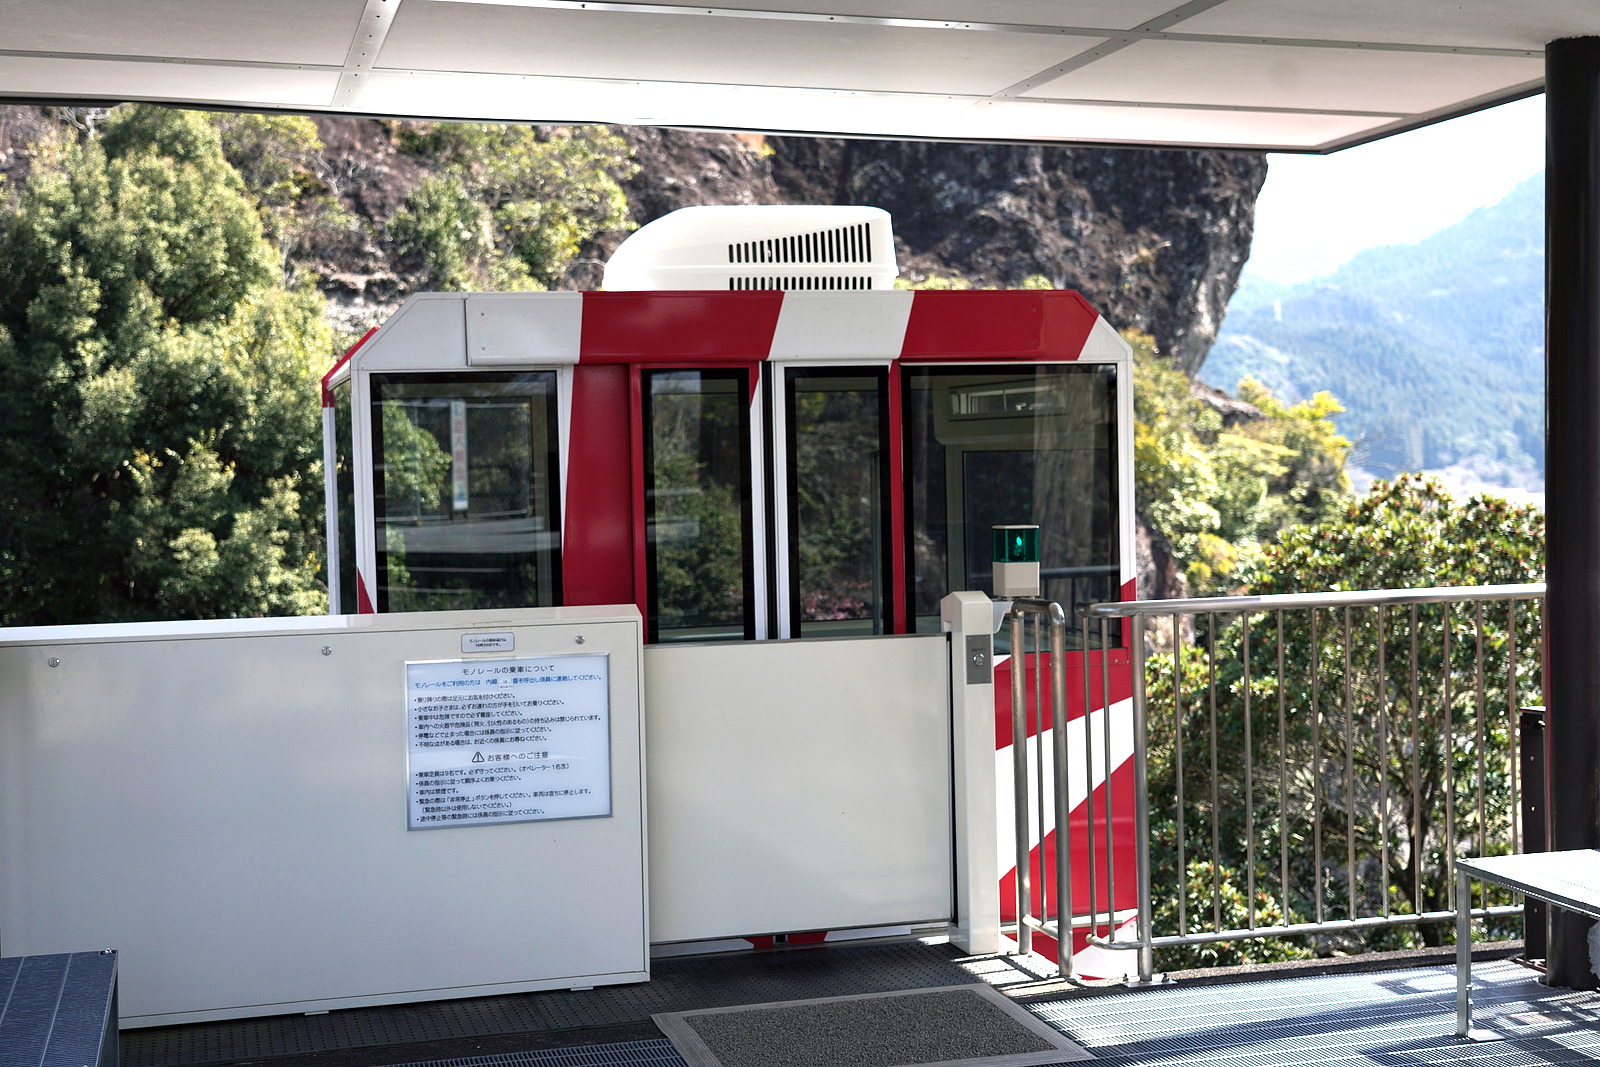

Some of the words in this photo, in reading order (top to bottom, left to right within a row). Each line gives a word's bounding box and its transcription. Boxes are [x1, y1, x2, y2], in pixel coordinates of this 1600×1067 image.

[462, 665, 555, 676] モノレールの乗車について
[415, 680, 481, 688] モノレールをご利用の方は
[487, 751, 549, 762] お客様へのご注意
